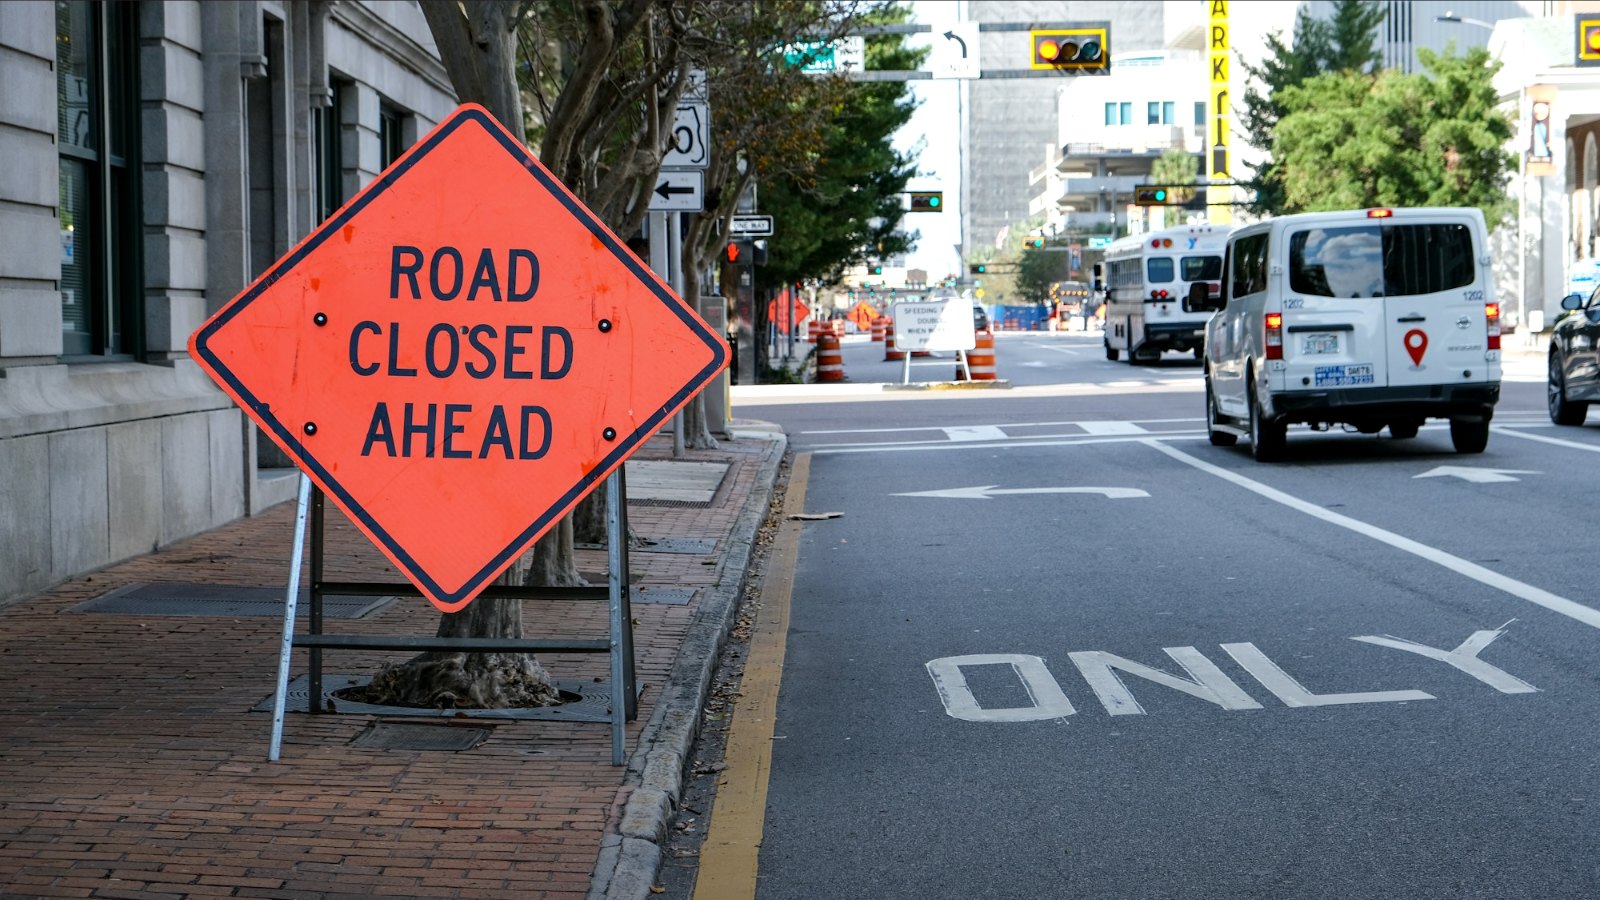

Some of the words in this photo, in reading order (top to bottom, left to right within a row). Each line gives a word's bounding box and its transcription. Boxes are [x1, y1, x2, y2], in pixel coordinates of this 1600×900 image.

[389, 245, 540, 302] ROAD
[1462, 290, 1484, 301] 1202
[904, 307, 937, 315] SPEEDING
[1283, 298, 1305, 309] 1202
[349, 320, 574, 380] CLOSED
[360, 402, 553, 460] AHEAD
[926, 620, 1540, 722] ONLY
